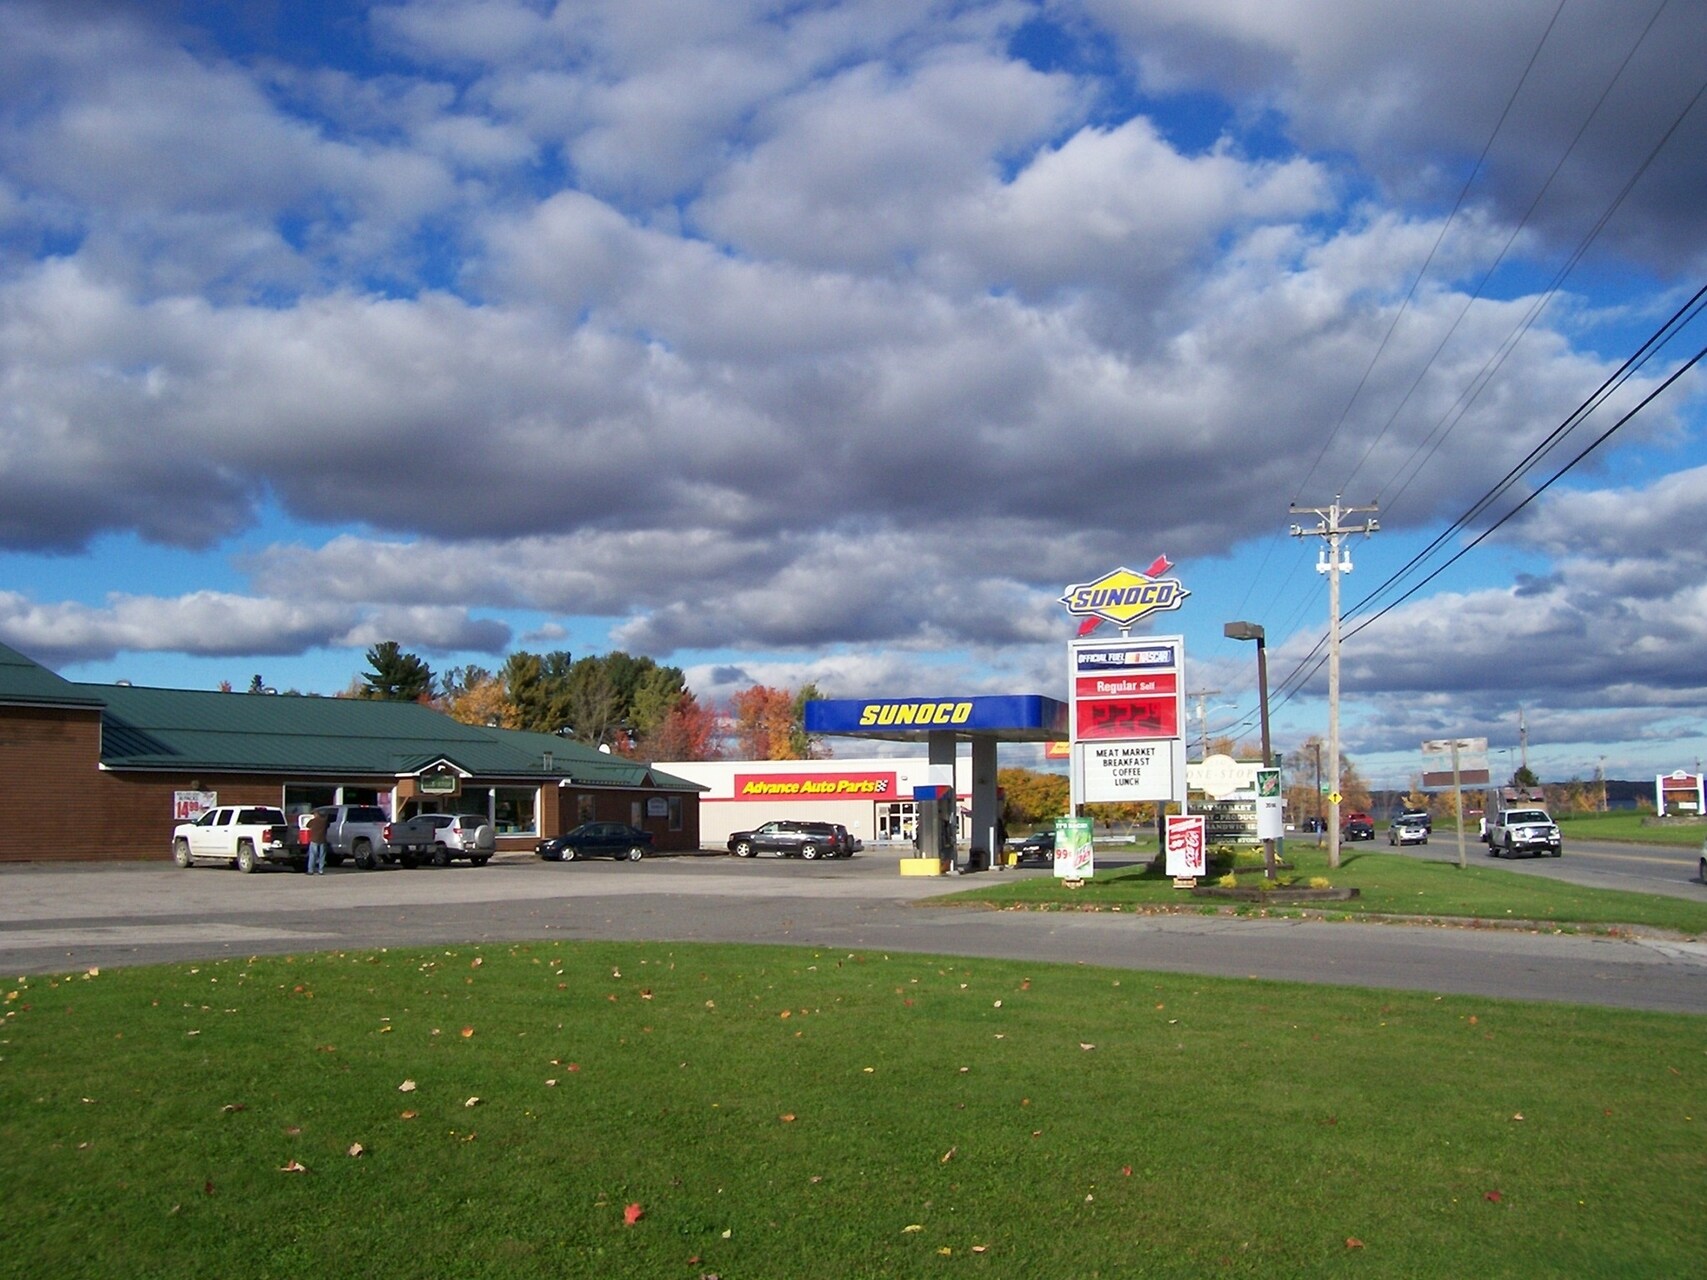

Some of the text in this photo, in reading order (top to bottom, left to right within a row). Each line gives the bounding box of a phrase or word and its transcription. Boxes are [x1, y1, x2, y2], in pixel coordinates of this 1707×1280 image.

[1074, 584, 1174, 608] SUNOCO
[1078, 653, 1107, 664] OFFICIAL
[1096, 680, 1155, 695] Regular Self
[859, 701, 973, 725] SUNOCO
[1096, 747, 1155, 758] MEAT MARKET
[1103, 758, 1150, 767] BREAKFAST
[1112, 767, 1141, 777] COFFEE
[741, 779, 875, 795] Advance Auto Parts
[1115, 777, 1140, 786] LUNCH
